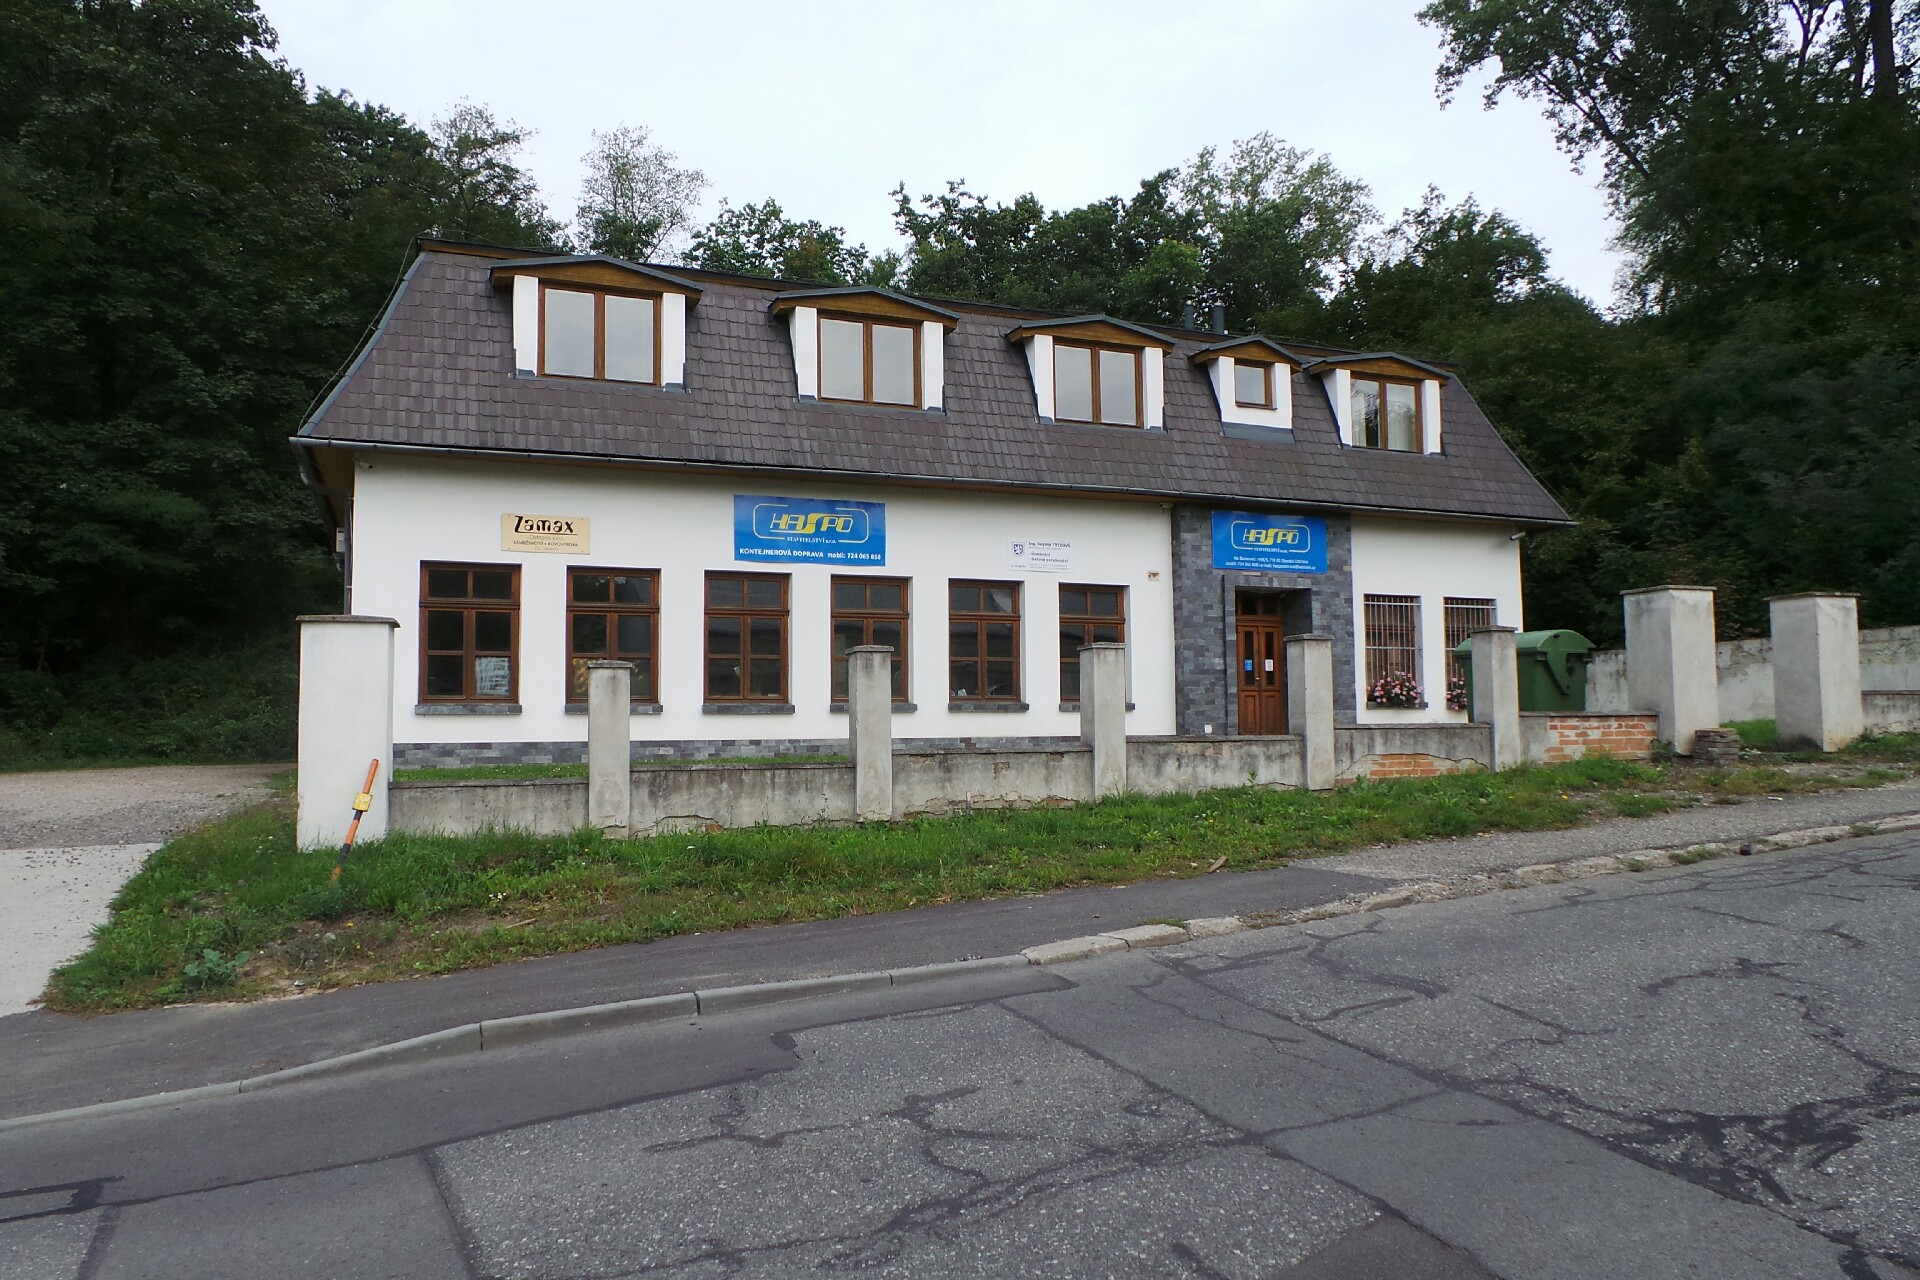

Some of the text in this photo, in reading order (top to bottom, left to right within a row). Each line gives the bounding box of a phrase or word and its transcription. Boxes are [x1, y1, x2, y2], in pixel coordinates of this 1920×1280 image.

[514, 515, 576, 535] Zamax
[770, 513, 854, 534] HASPO
[1243, 528, 1299, 545] HASPO
[739, 548, 792, 557] KONTEJNEROVÁ
[792, 550, 824, 558] DOPRAVA
[847, 552, 858, 560] 724
